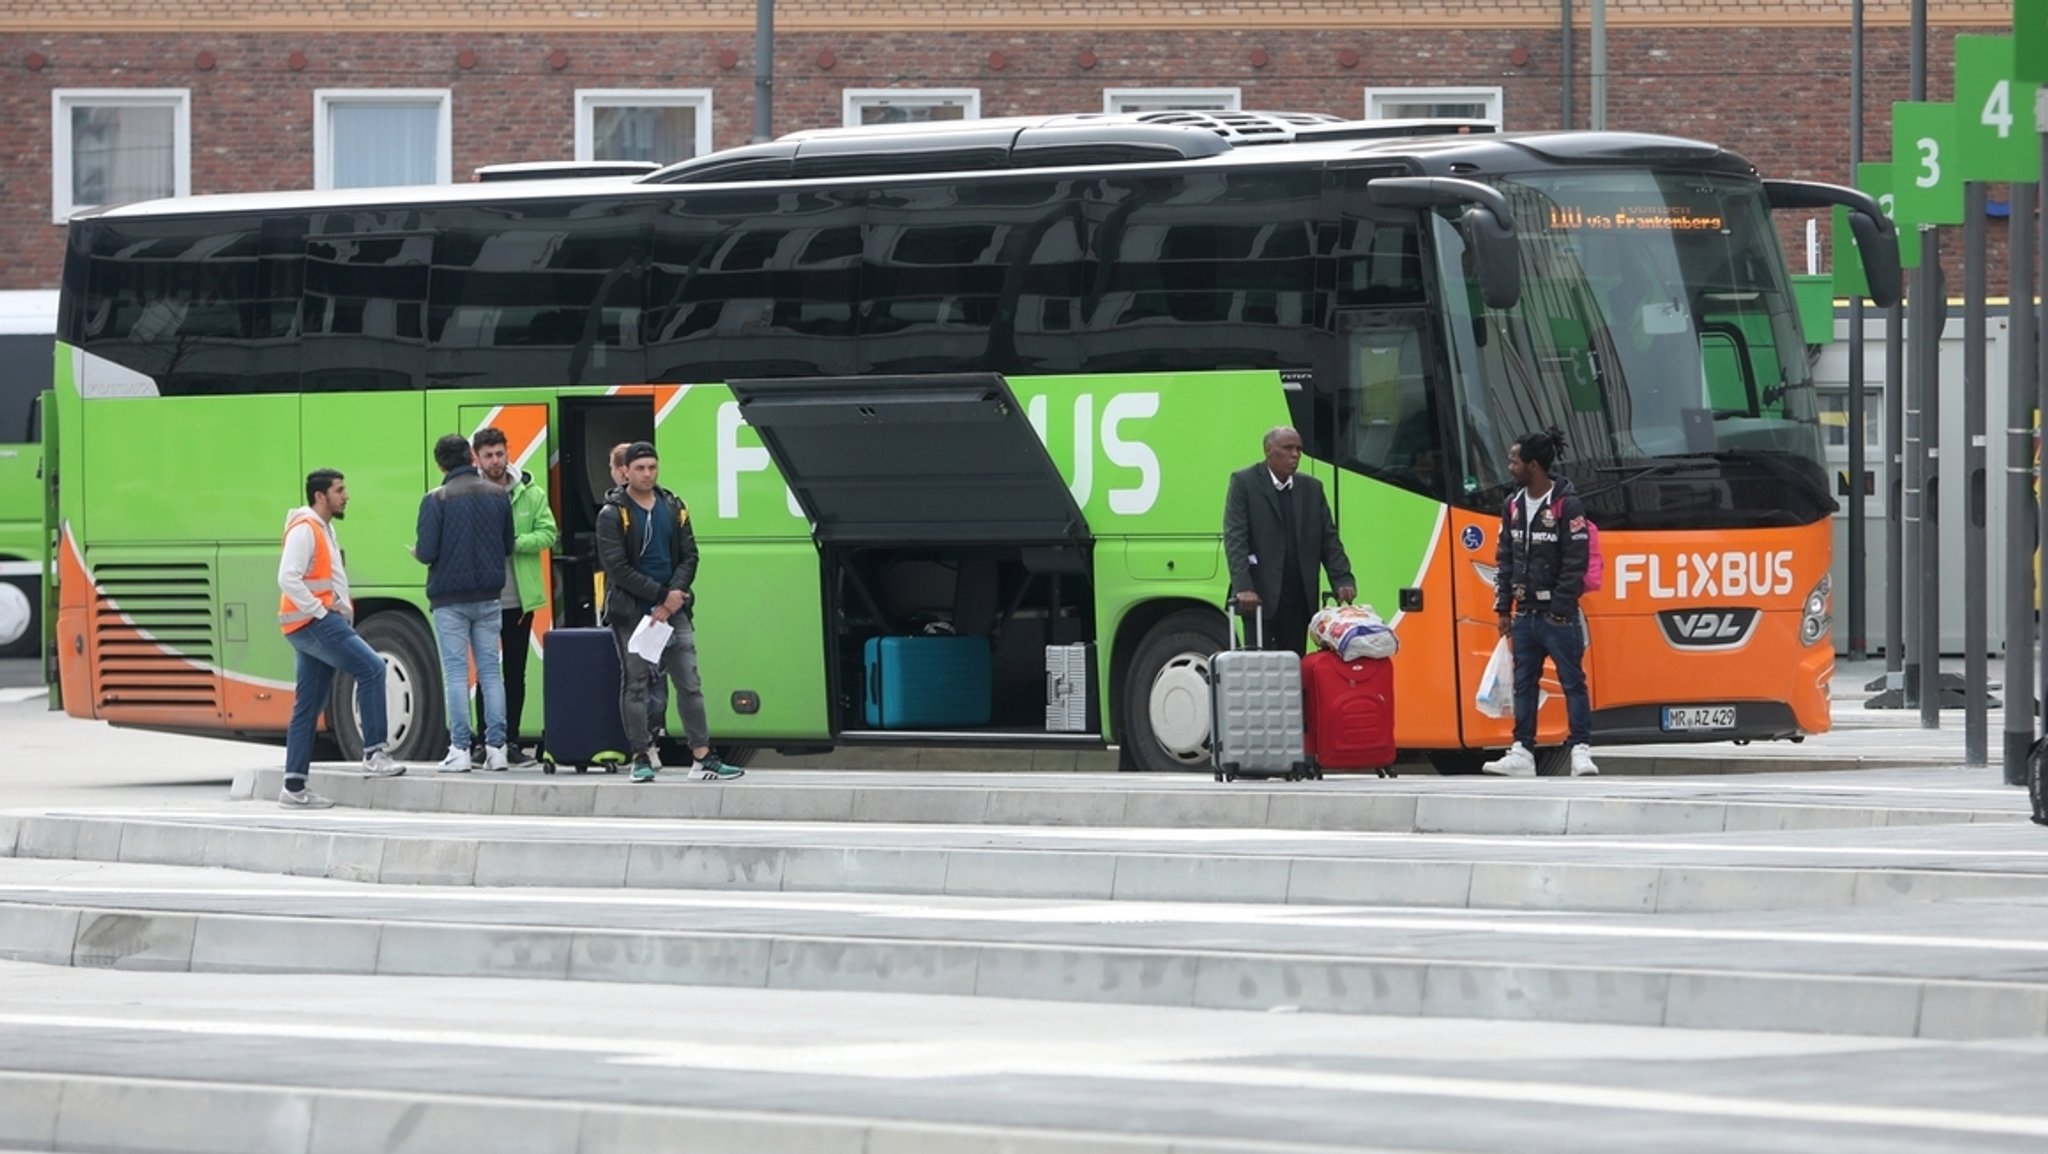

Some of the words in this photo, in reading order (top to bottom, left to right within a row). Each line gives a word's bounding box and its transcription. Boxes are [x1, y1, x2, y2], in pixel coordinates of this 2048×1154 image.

[1981, 80, 2013, 138] 4
[1915, 137, 1941, 188] 3
[1587, 215, 1611, 229] via
[1615, 213, 1721, 229] Frankenberg
[1672, 614, 1740, 638] VDL
[1670, 710, 1686, 727] MR
[1695, 710, 1710, 726] AZ
[1712, 709, 1735, 726] 429
